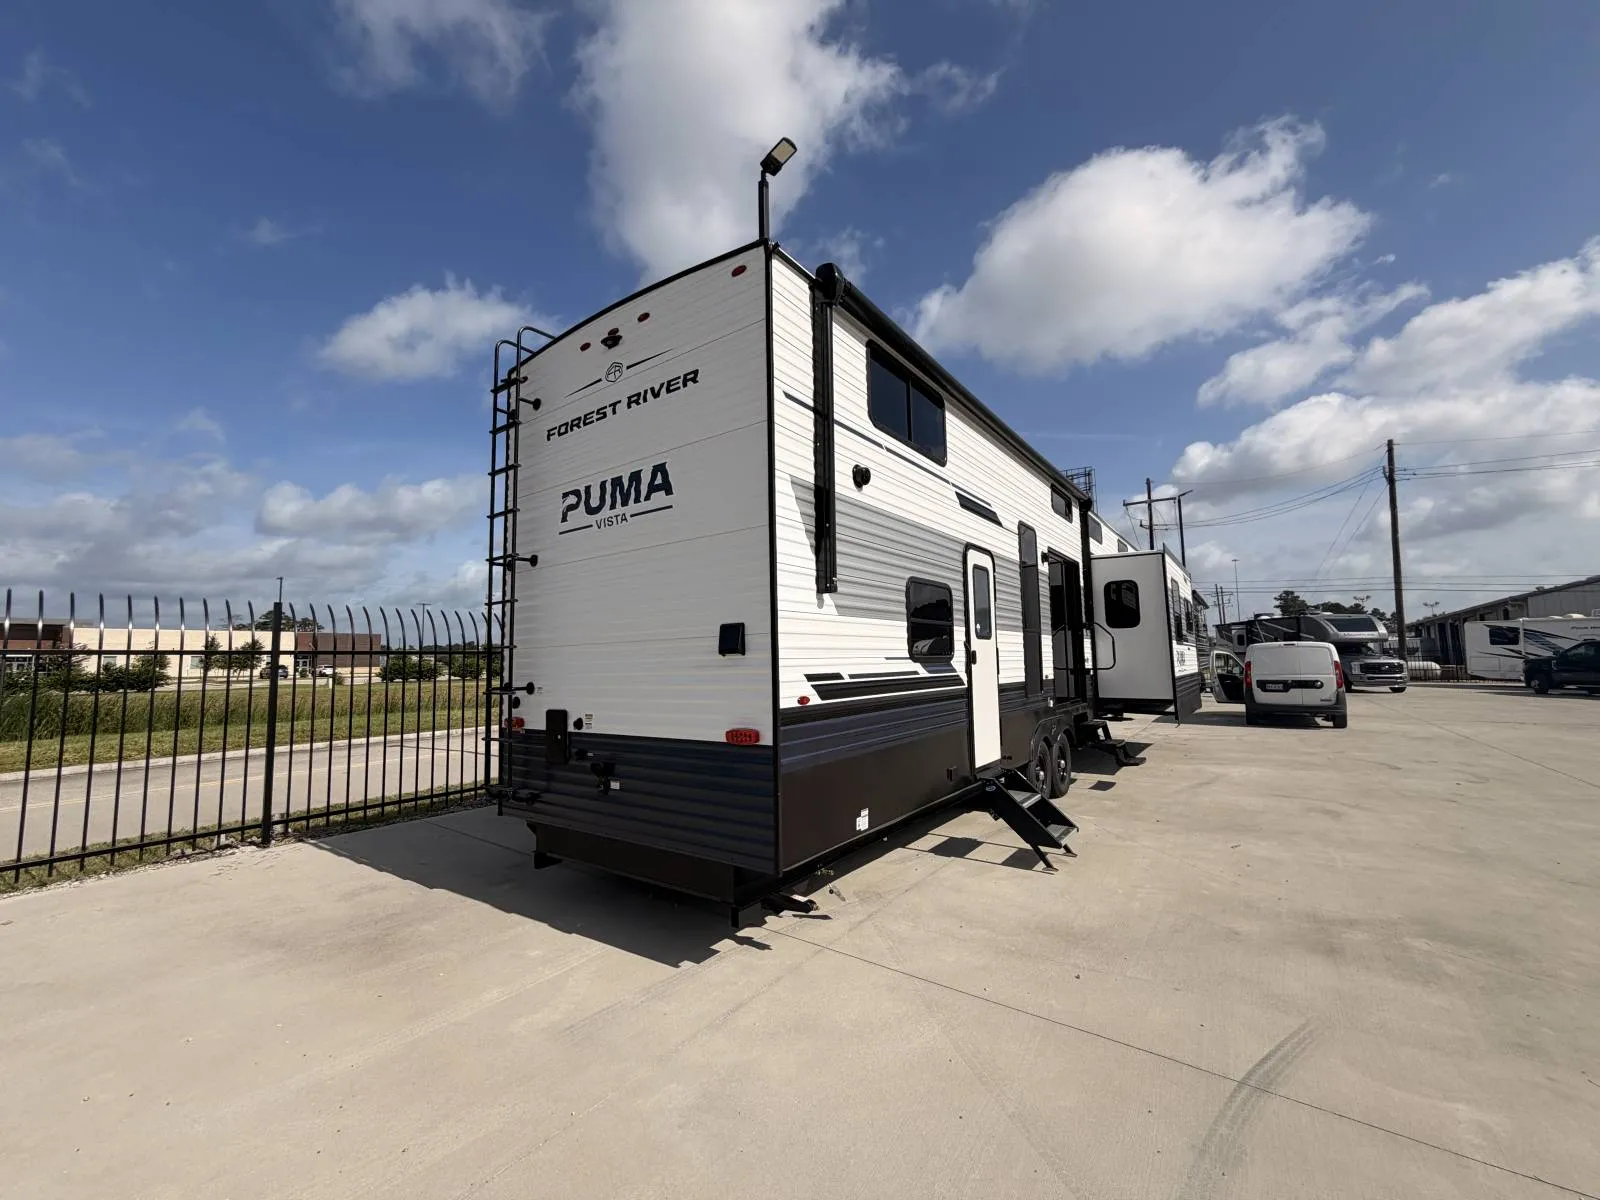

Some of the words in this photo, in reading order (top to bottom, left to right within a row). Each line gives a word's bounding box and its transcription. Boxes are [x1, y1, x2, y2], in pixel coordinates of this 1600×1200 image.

[546, 399, 622, 441] FOREST
[626, 368, 700, 410] RIVER
[560, 461, 674, 524] PUMA
[595, 512, 629, 530] VISTA
